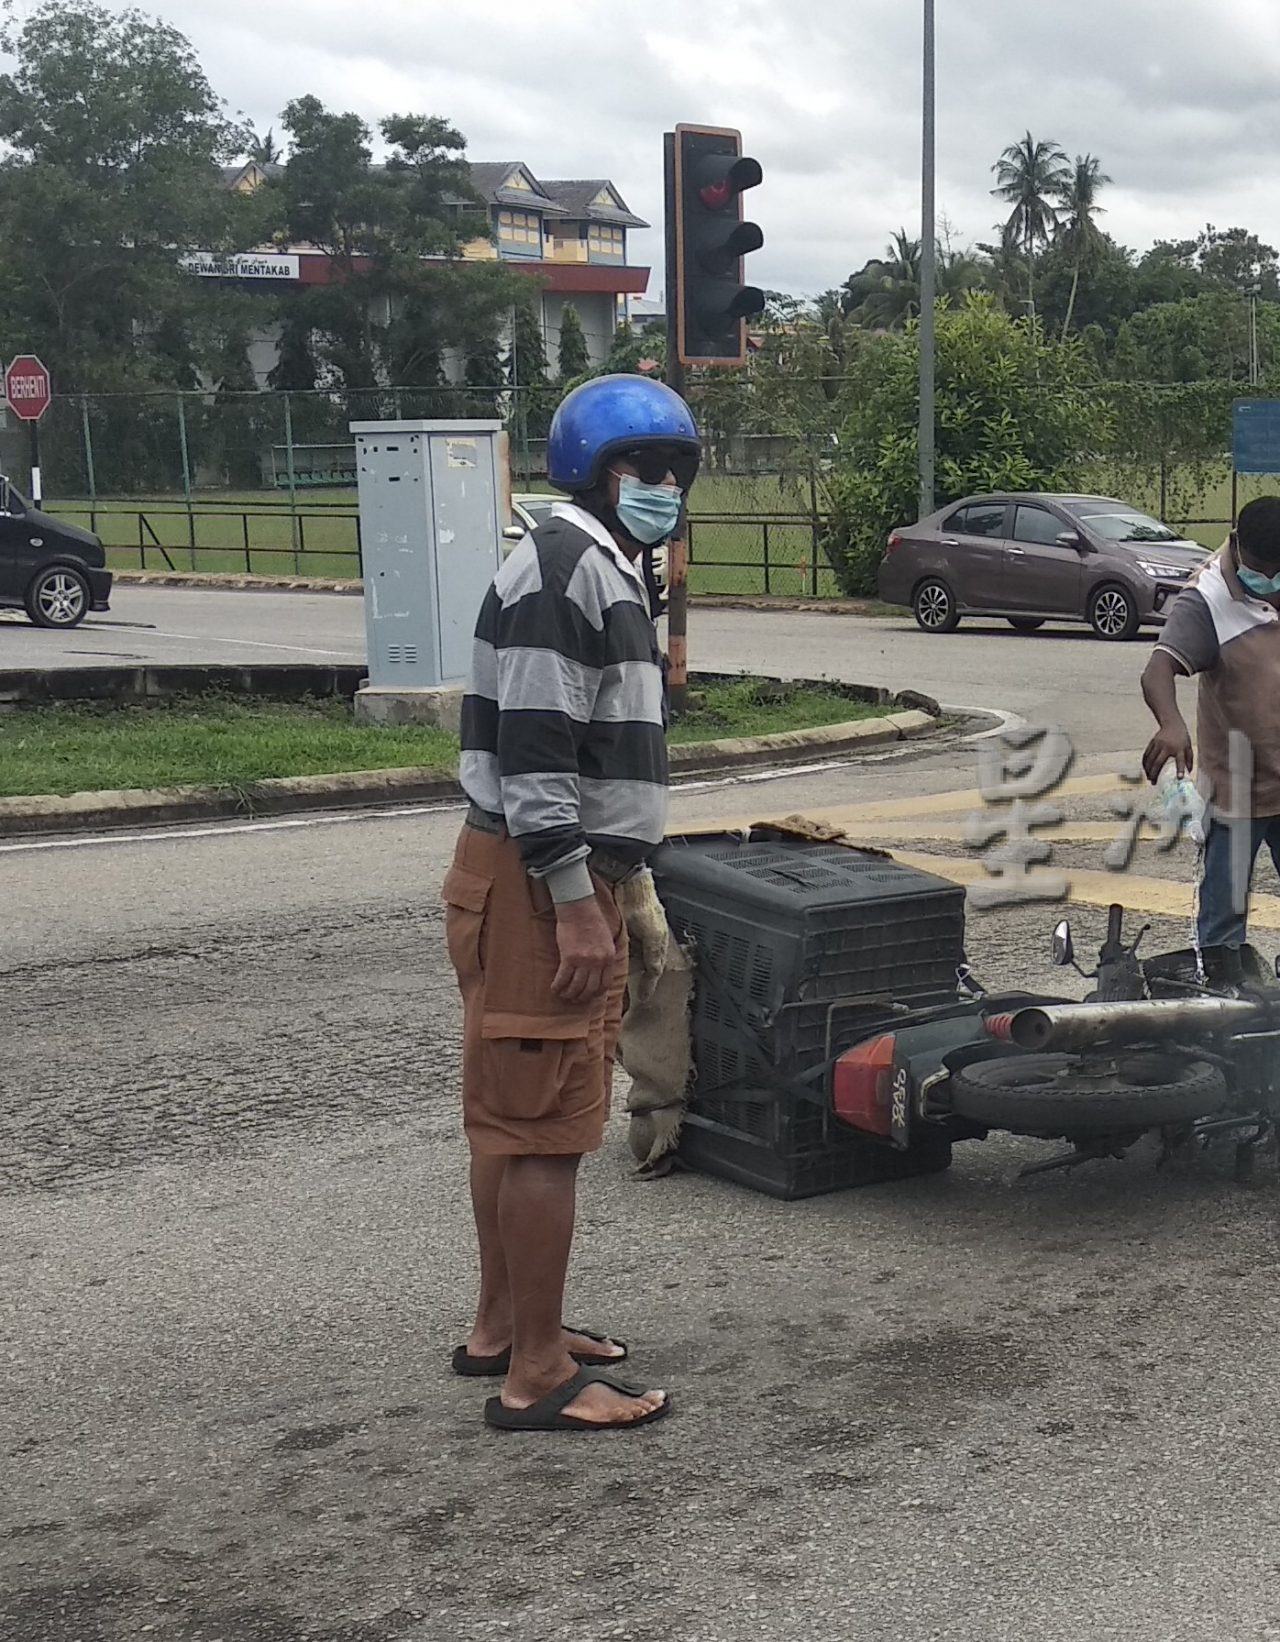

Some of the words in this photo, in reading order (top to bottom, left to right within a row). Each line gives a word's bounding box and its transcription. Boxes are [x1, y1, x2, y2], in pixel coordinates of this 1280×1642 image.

[189, 262, 221, 274] DEWAN
[241, 265, 290, 276] MENTAKAB
[10, 375, 46, 399] BERHENTI
